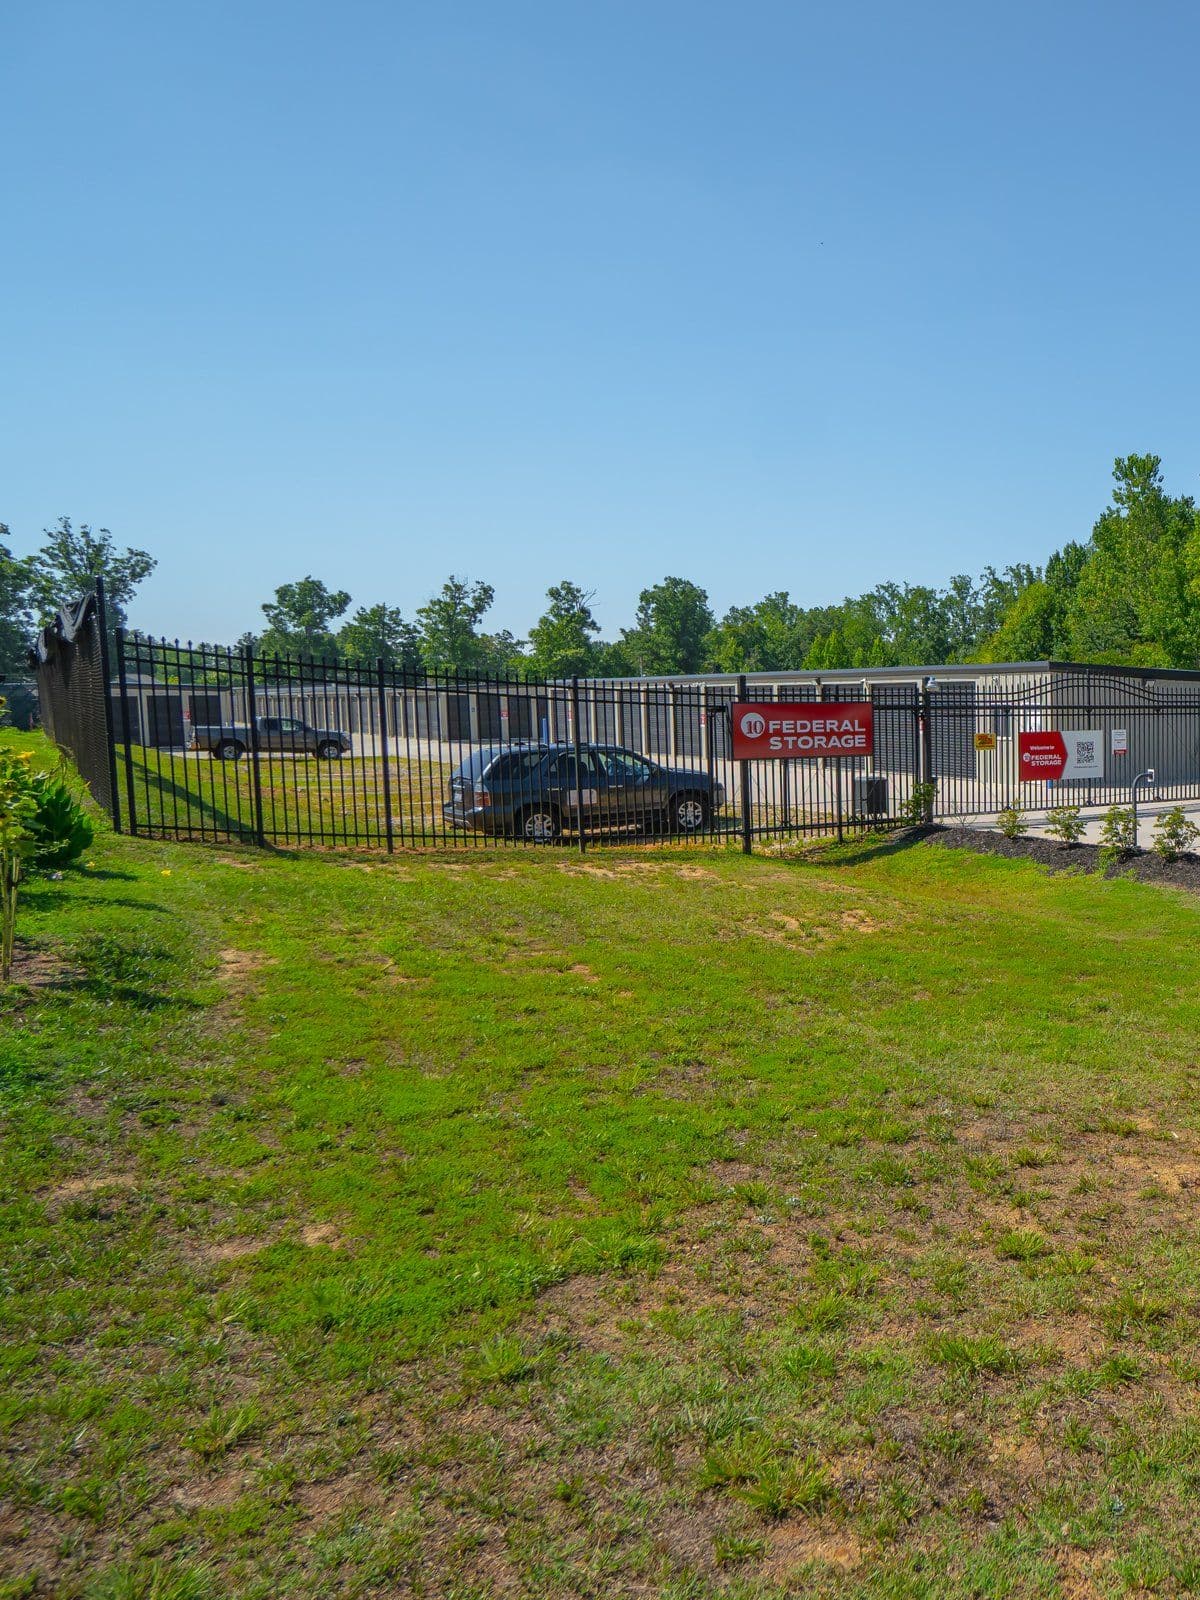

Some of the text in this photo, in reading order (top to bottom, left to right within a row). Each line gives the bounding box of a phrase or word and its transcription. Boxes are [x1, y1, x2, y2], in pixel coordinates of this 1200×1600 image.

[745, 719, 866, 734] 10 FEDERAL
[769, 735, 866, 750] STORAGE
